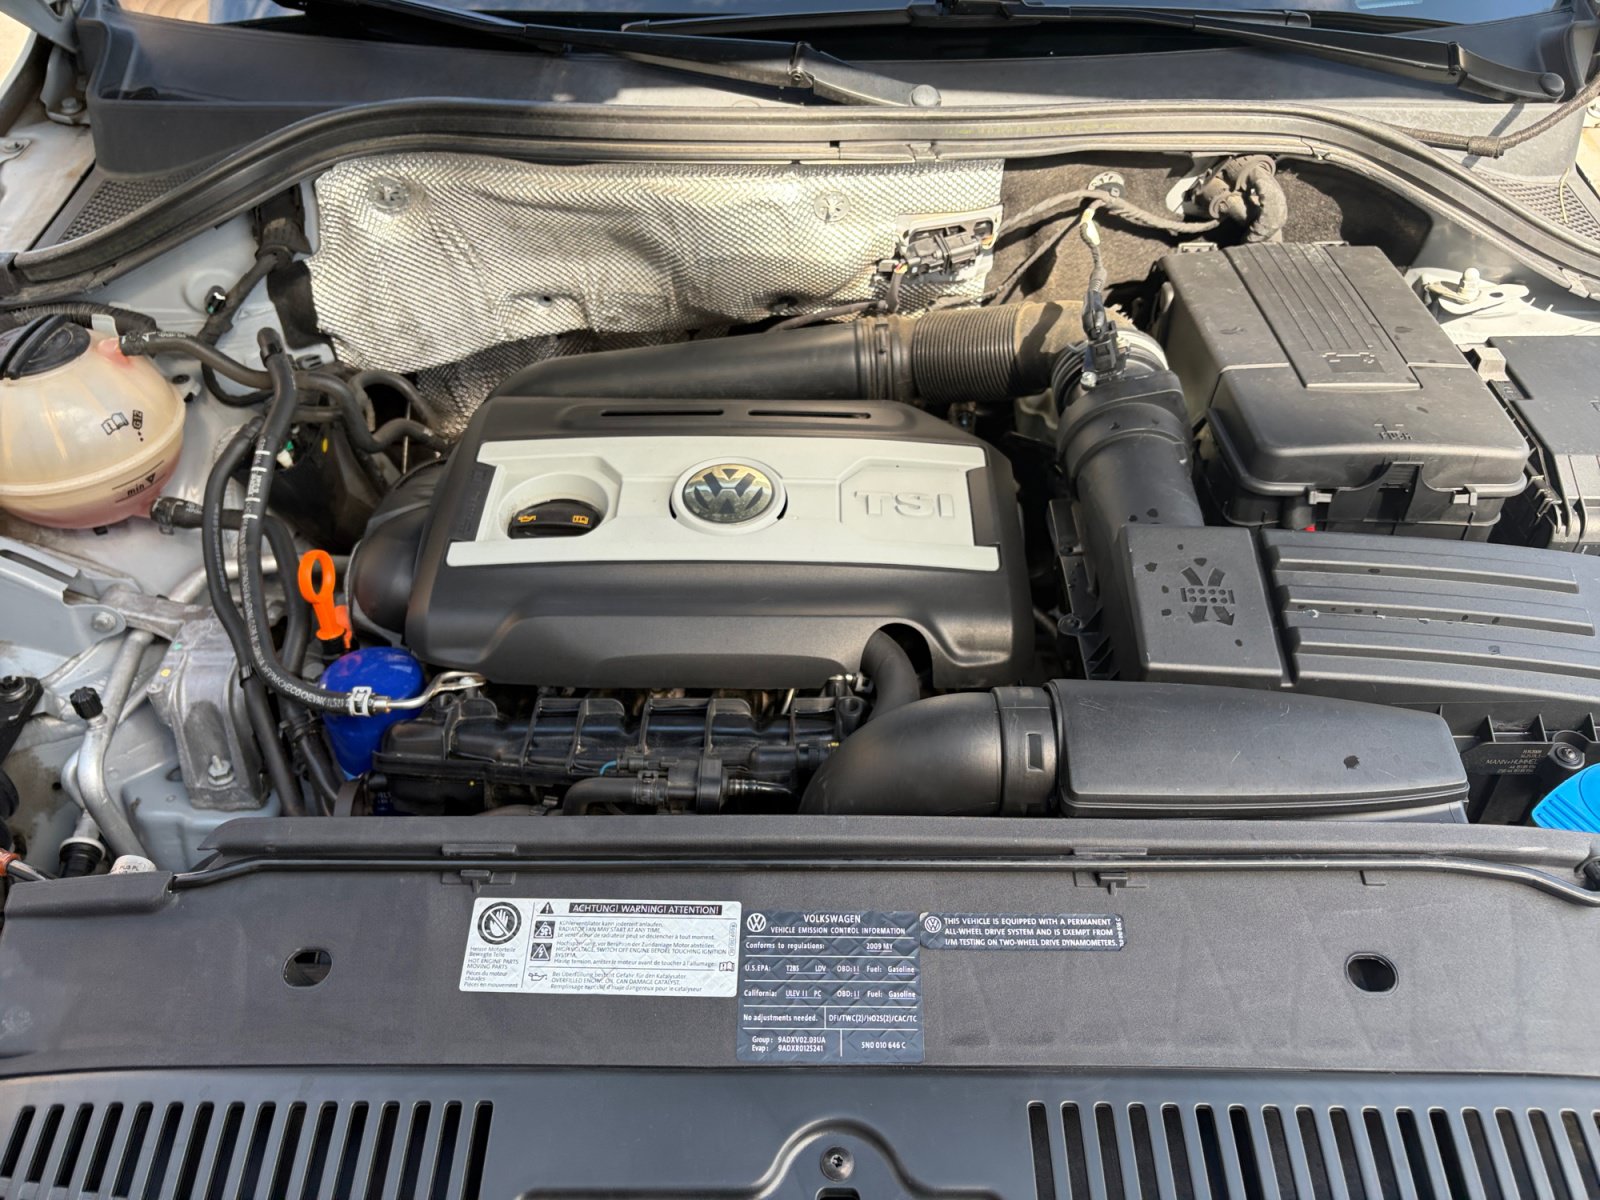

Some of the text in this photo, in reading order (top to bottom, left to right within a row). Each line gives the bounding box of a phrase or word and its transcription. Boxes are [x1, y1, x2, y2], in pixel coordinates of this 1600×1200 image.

[127, 484, 145, 496] min
[855, 490, 955, 518] TSI
[572, 904, 719, 914] ACHTUNG! WARNING! ATTENTION!
[804, 914, 860, 923] VOLKSWAGEN
[788, 942, 824, 950] regulations:
[754, 1014, 792, 1023] adjustments
